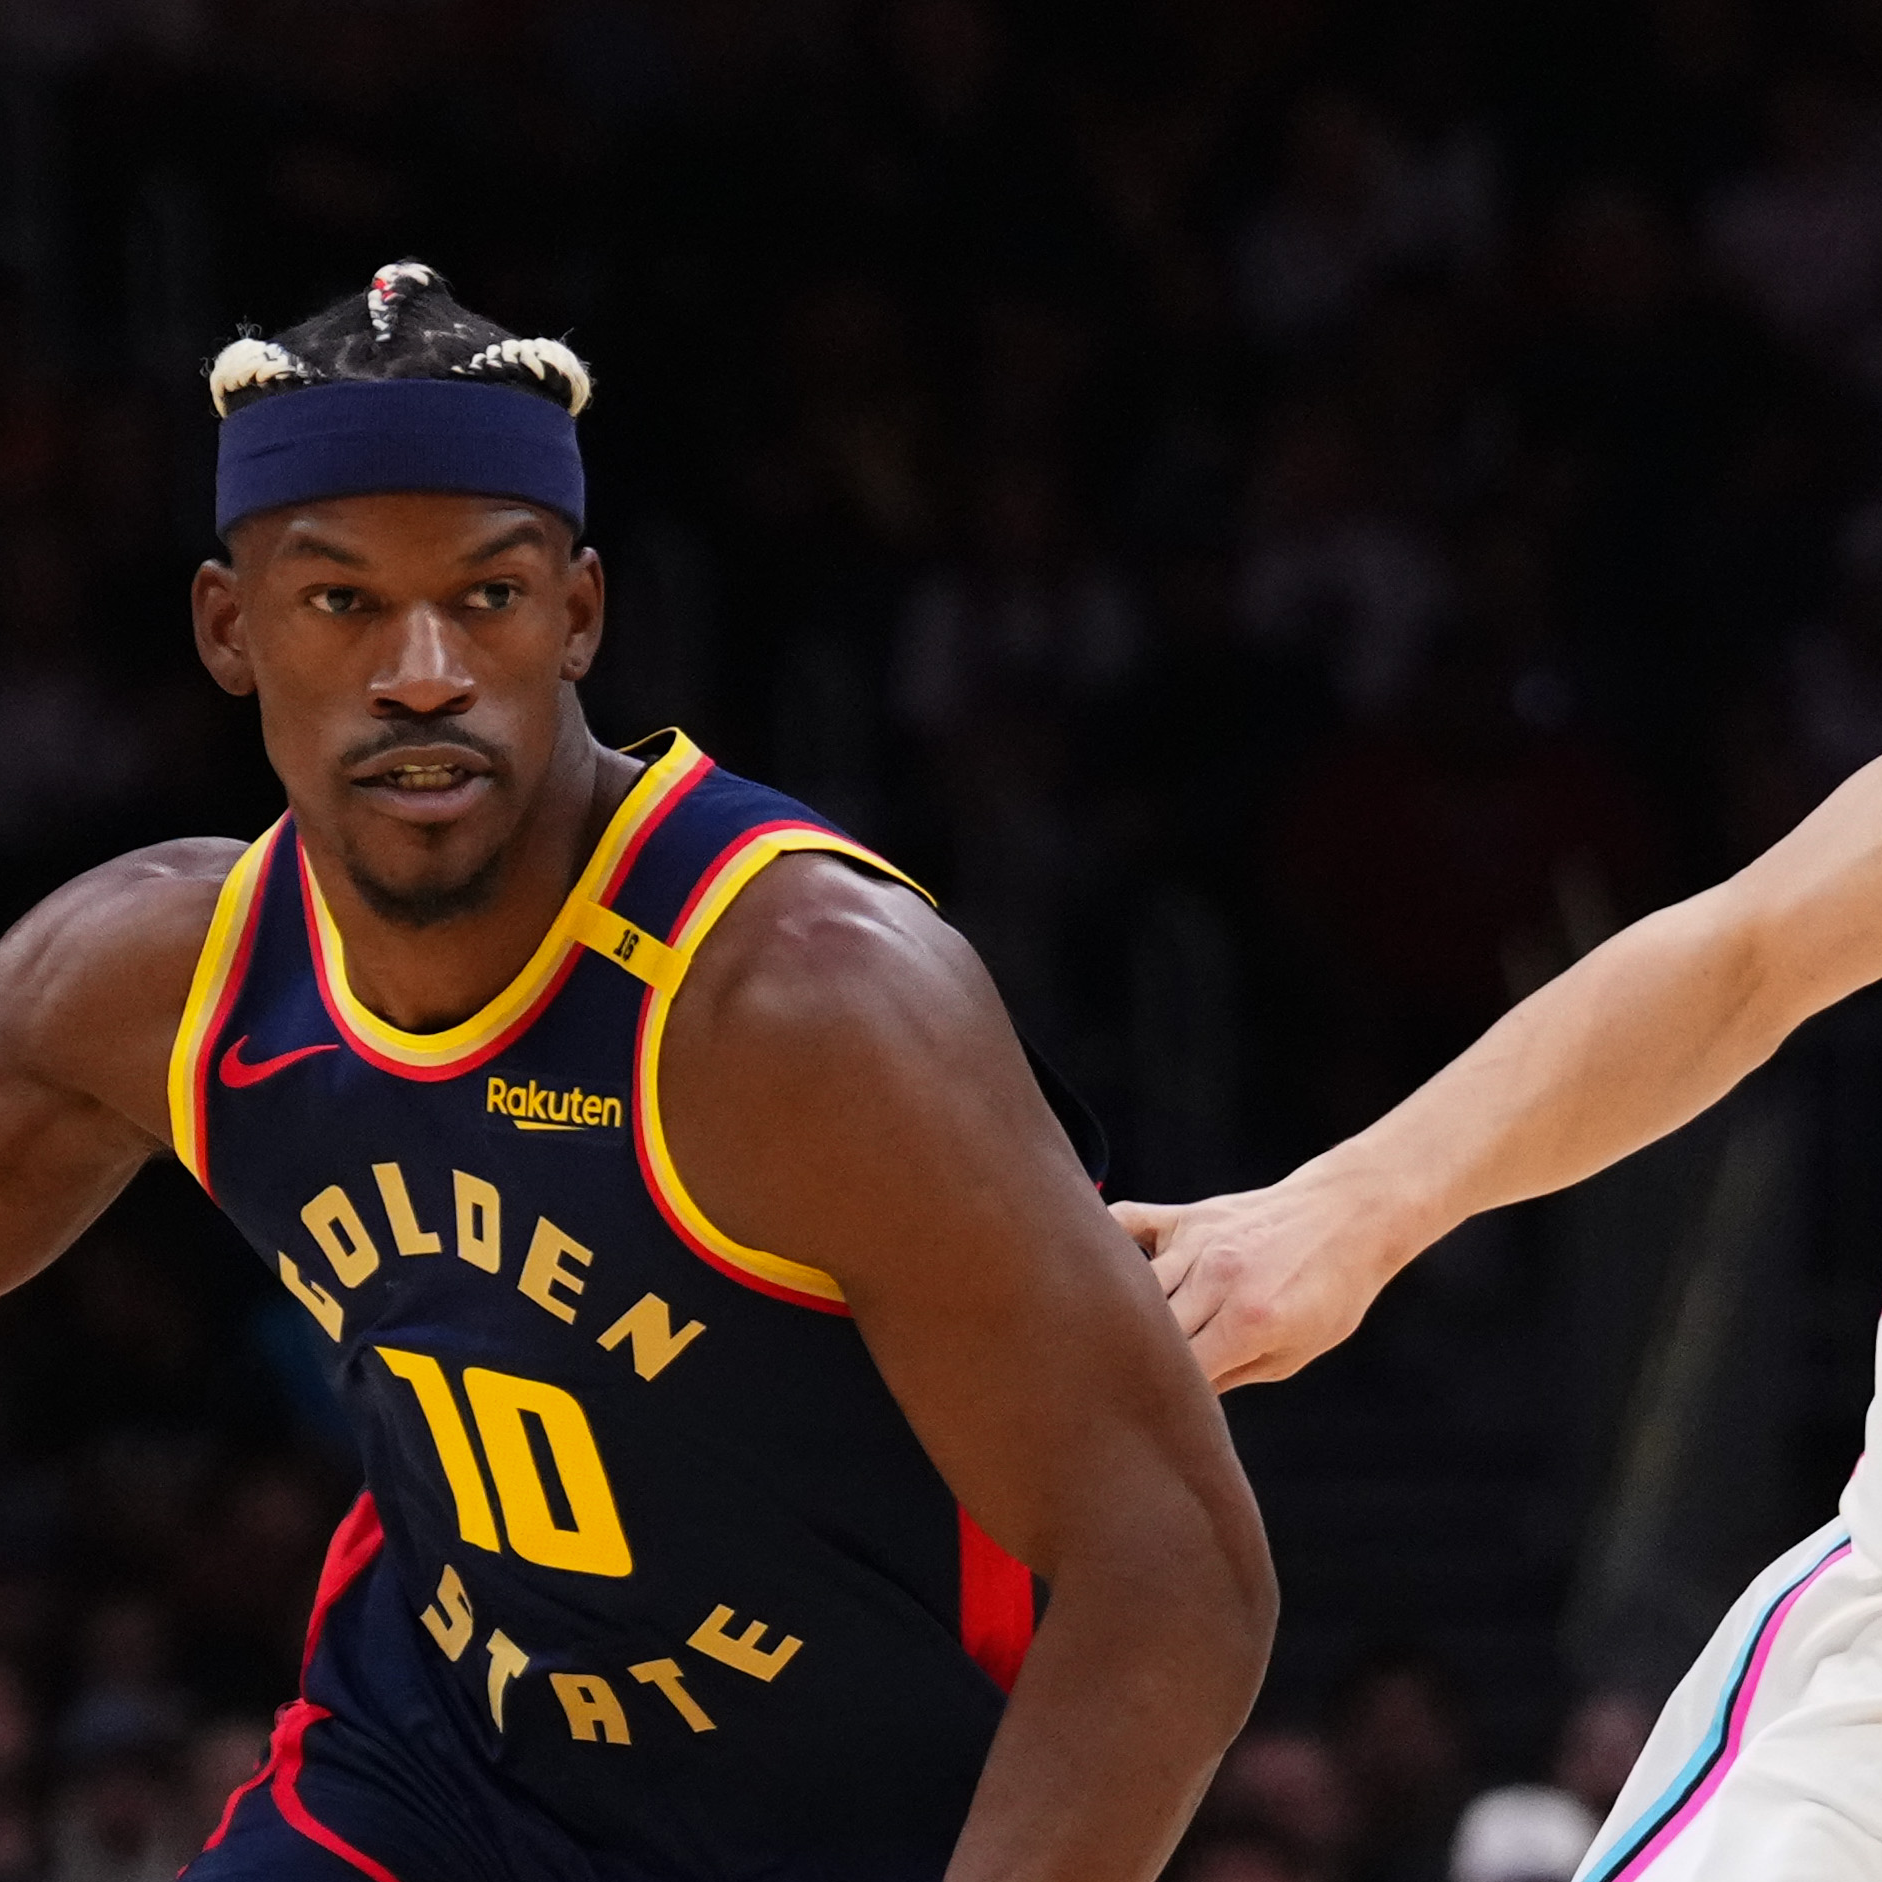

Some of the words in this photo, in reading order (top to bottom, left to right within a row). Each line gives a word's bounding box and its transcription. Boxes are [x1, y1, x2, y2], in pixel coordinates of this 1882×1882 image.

[613, 929, 639, 962] 16
[486, 1076, 622, 1129] Rakuten
[277, 1161, 707, 1382] GOLDEN
[373, 1345, 633, 1578] 10
[419, 1563, 804, 1747] STATE
